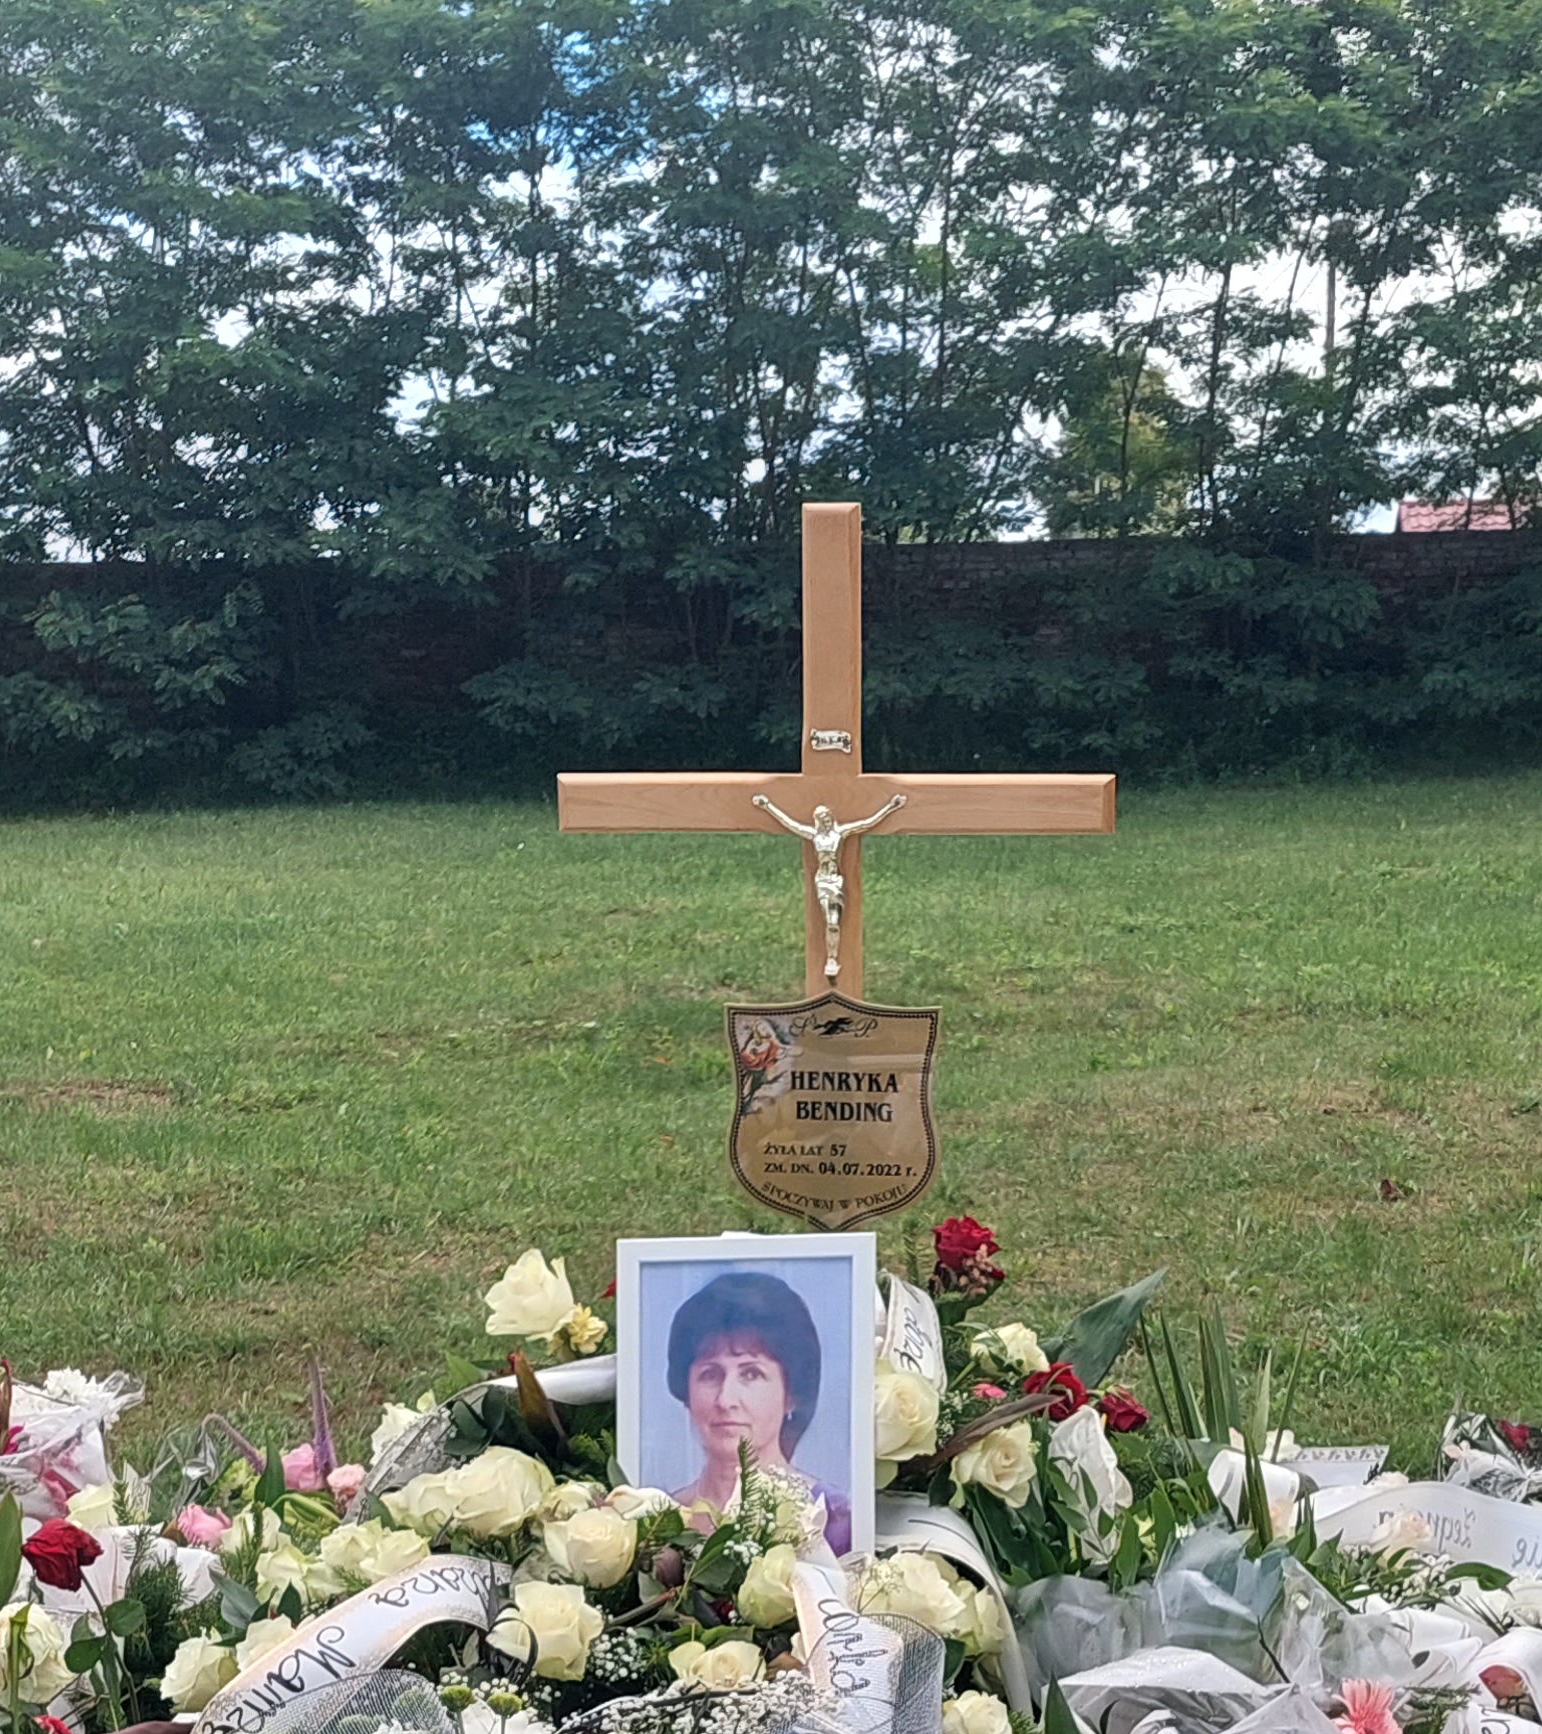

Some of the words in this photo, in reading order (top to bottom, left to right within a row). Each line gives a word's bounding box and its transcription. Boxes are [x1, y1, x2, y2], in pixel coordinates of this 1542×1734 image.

[790, 1070, 899, 1093] HENRYKA
[796, 1101, 893, 1122] BENDING
[818, 1161, 901, 1177] 04.07.2022
